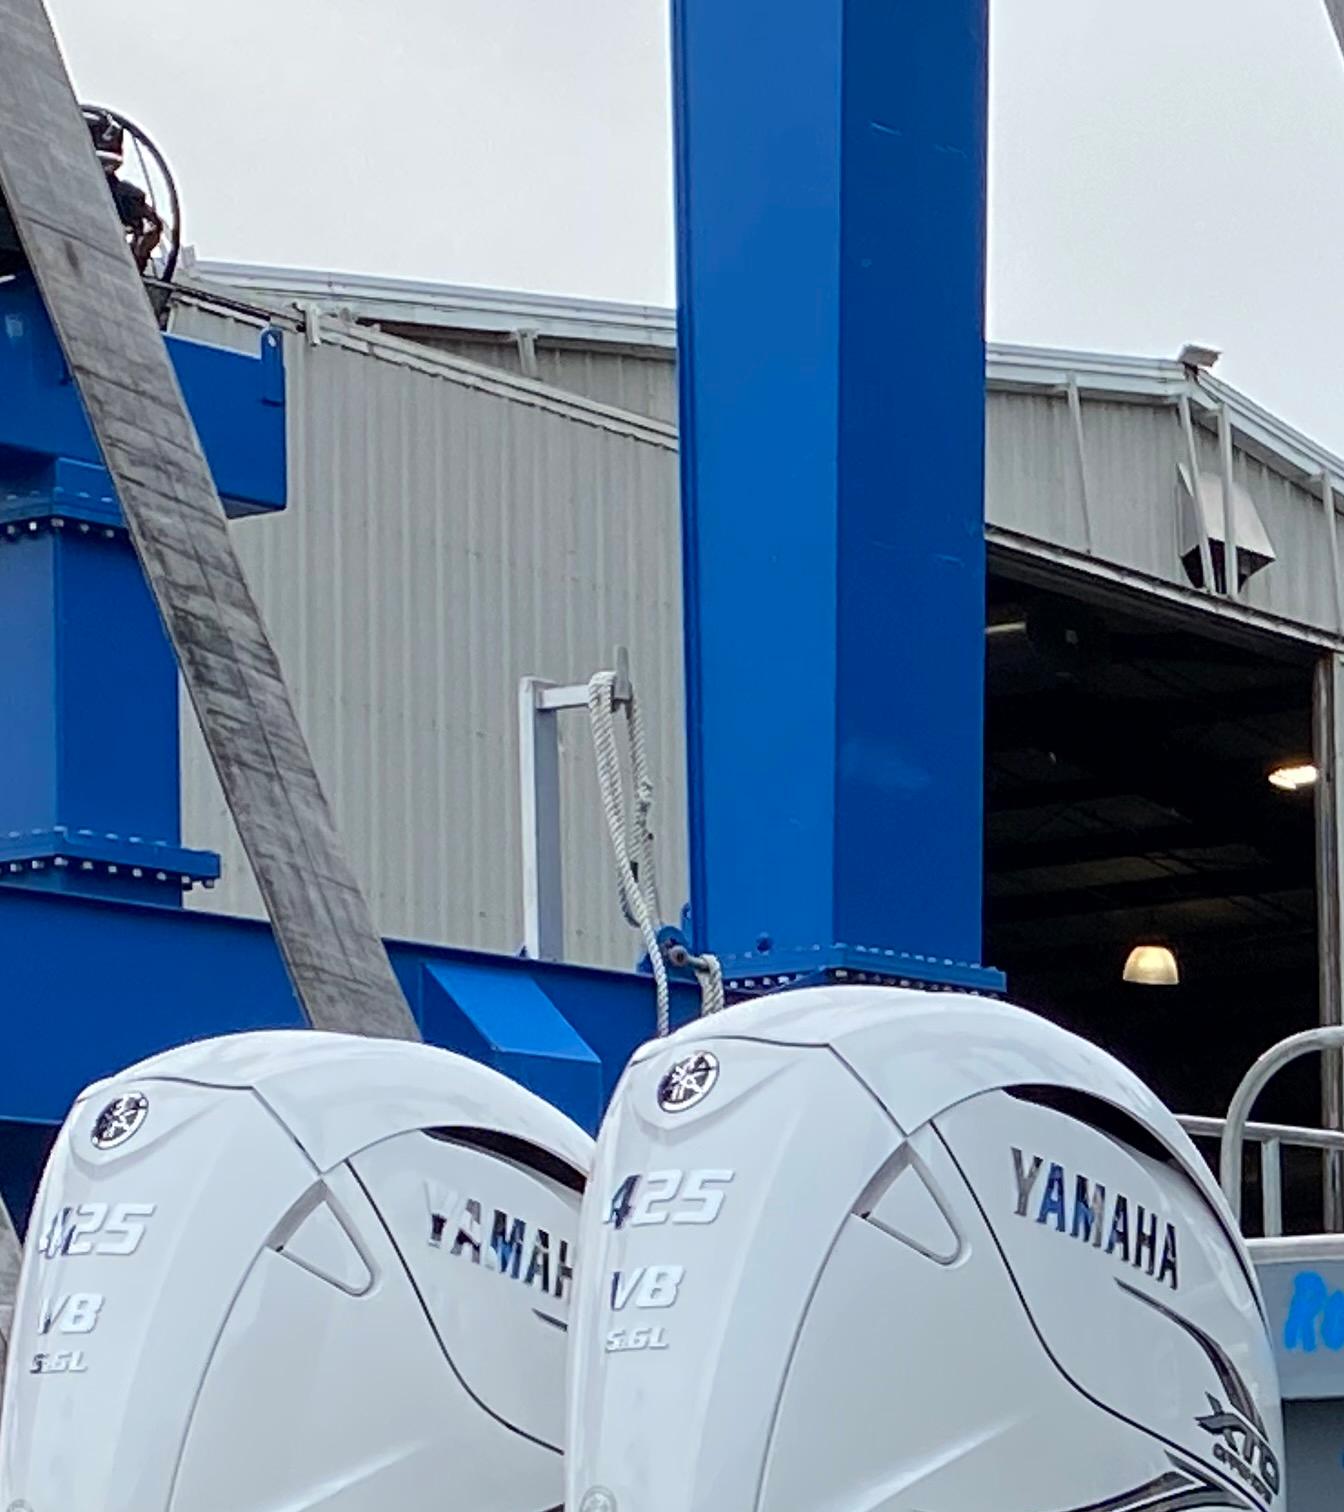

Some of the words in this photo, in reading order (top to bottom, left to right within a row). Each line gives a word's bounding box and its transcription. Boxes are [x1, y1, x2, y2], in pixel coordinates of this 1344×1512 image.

[601, 1168, 736, 1231] 425
[1010, 1146, 1179, 1291] YAMAHA
[423, 1178, 574, 1299] YAMAH
[37, 1292, 106, 1336] V8
[610, 1264, 687, 1312] V8
